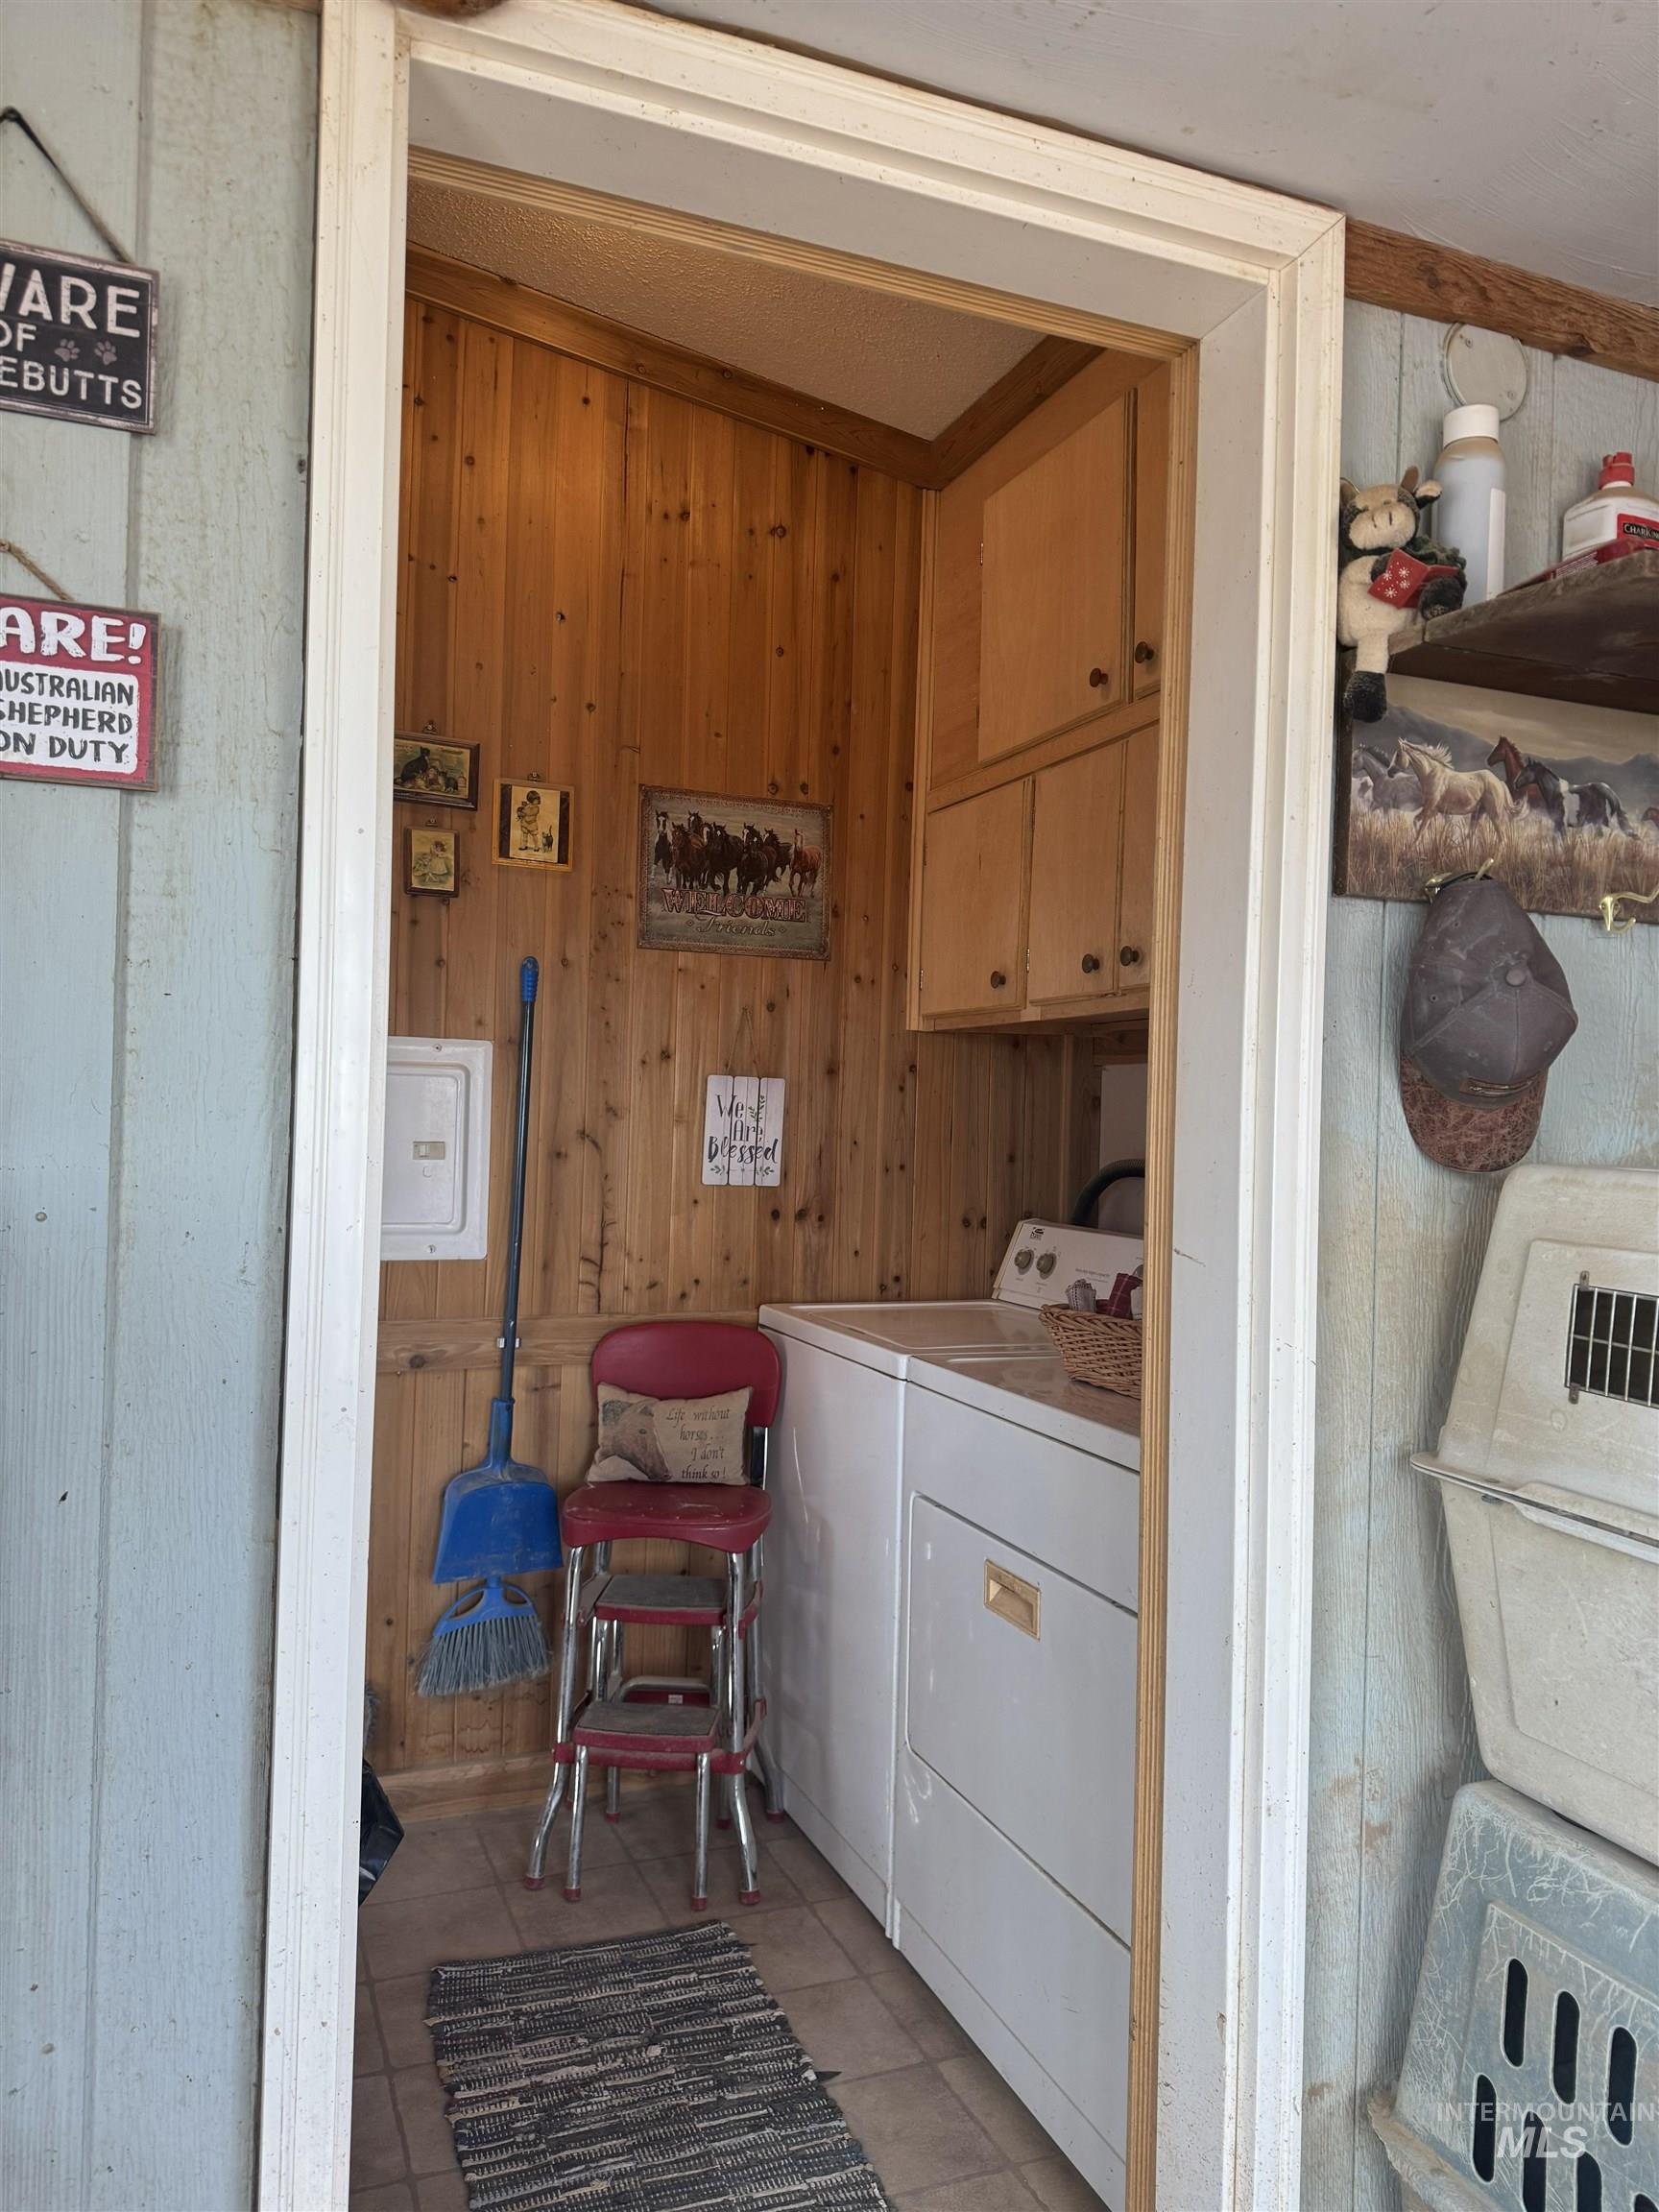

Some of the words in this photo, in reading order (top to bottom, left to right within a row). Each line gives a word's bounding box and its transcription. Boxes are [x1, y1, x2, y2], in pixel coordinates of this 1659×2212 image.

[0, 668, 133, 707] USTRALIAN
[0, 731, 36, 756] ON
[49, 735, 130, 764] DUTY
[661, 887, 807, 924] WELCOME
[694, 914, 777, 937] Friends
[715, 1094, 744, 1118] We
[733, 1119, 764, 1142] Are
[708, 1136, 779, 1164] Blessed
[665, 1407, 686, 1428] Life
[693, 1405, 730, 1421] without
[701, 1443, 725, 1460] don't
[682, 1464, 709, 1479] think
